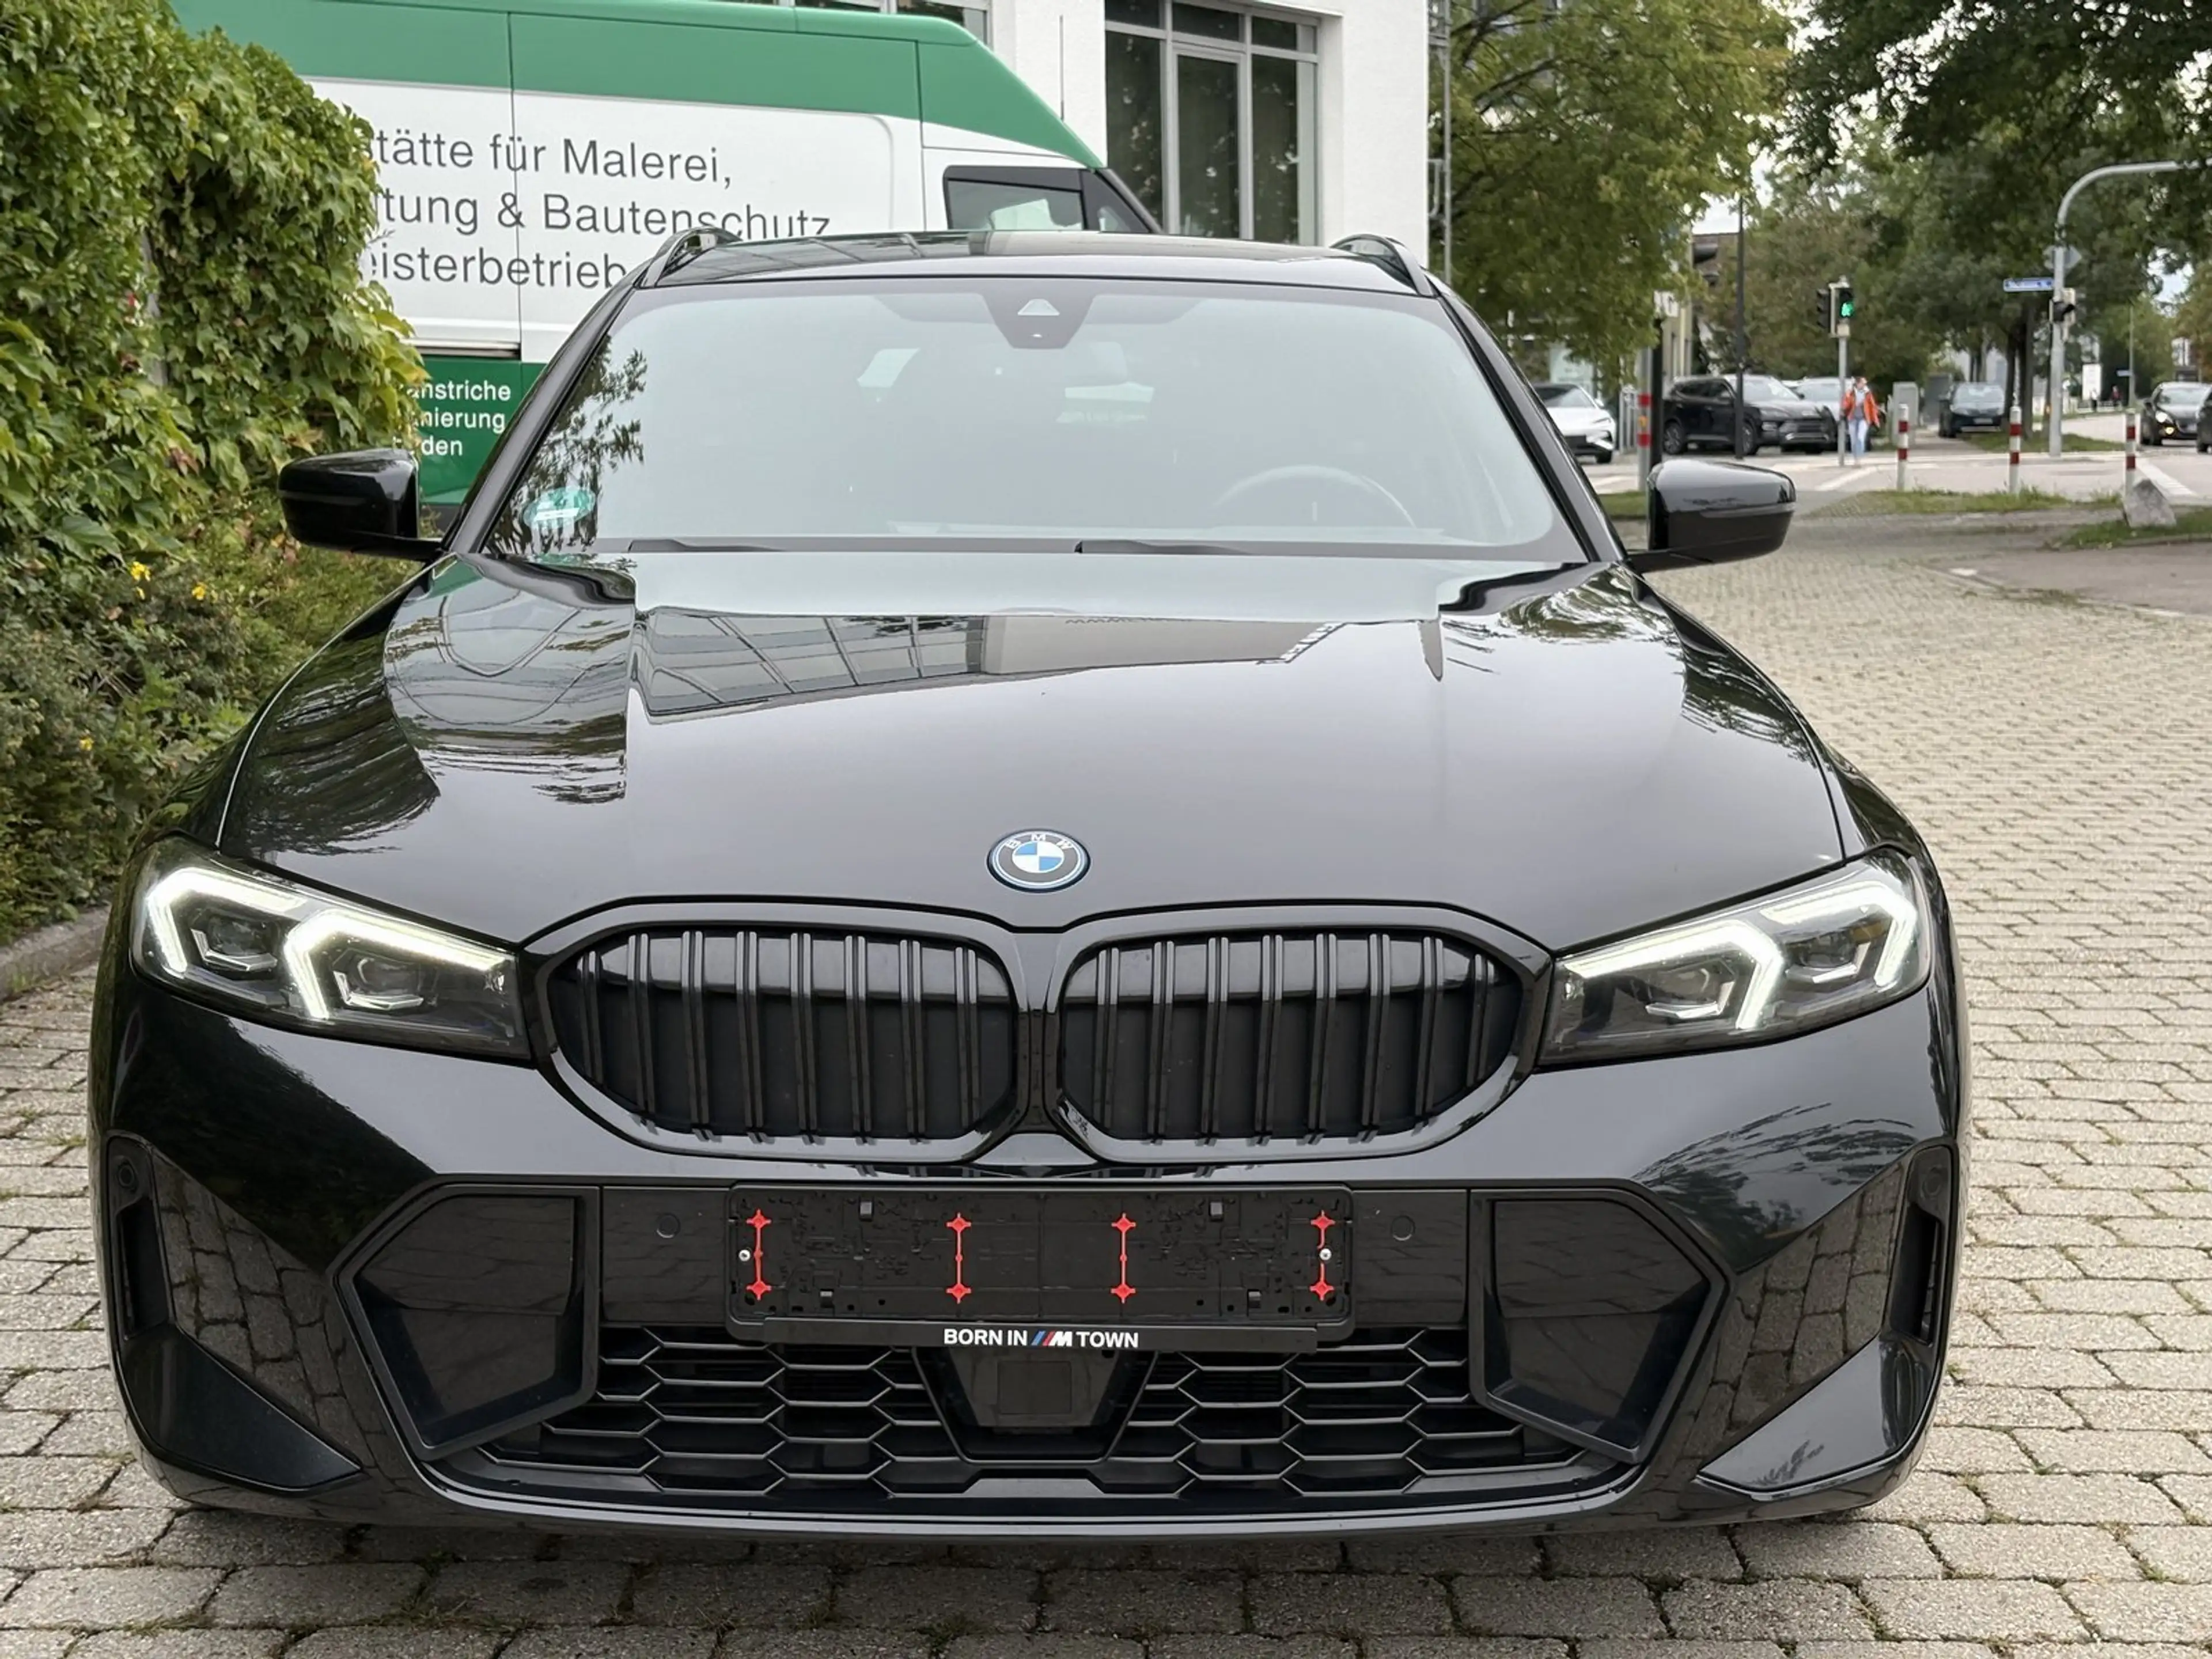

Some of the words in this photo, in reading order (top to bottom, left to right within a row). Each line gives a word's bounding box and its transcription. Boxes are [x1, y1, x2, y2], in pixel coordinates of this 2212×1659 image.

[369, 128, 475, 168] tätte
[489, 133, 547, 172] für
[564, 138, 731, 190] Malerei,
[497, 192, 526, 228] &
[411, 406, 505, 434] nierung
[1004, 833, 1075, 850] BMW
[944, 1328, 1003, 1346] BORN
[1007, 1329, 1028, 1346] IN
[1076, 1331, 1139, 1349] TOWN
